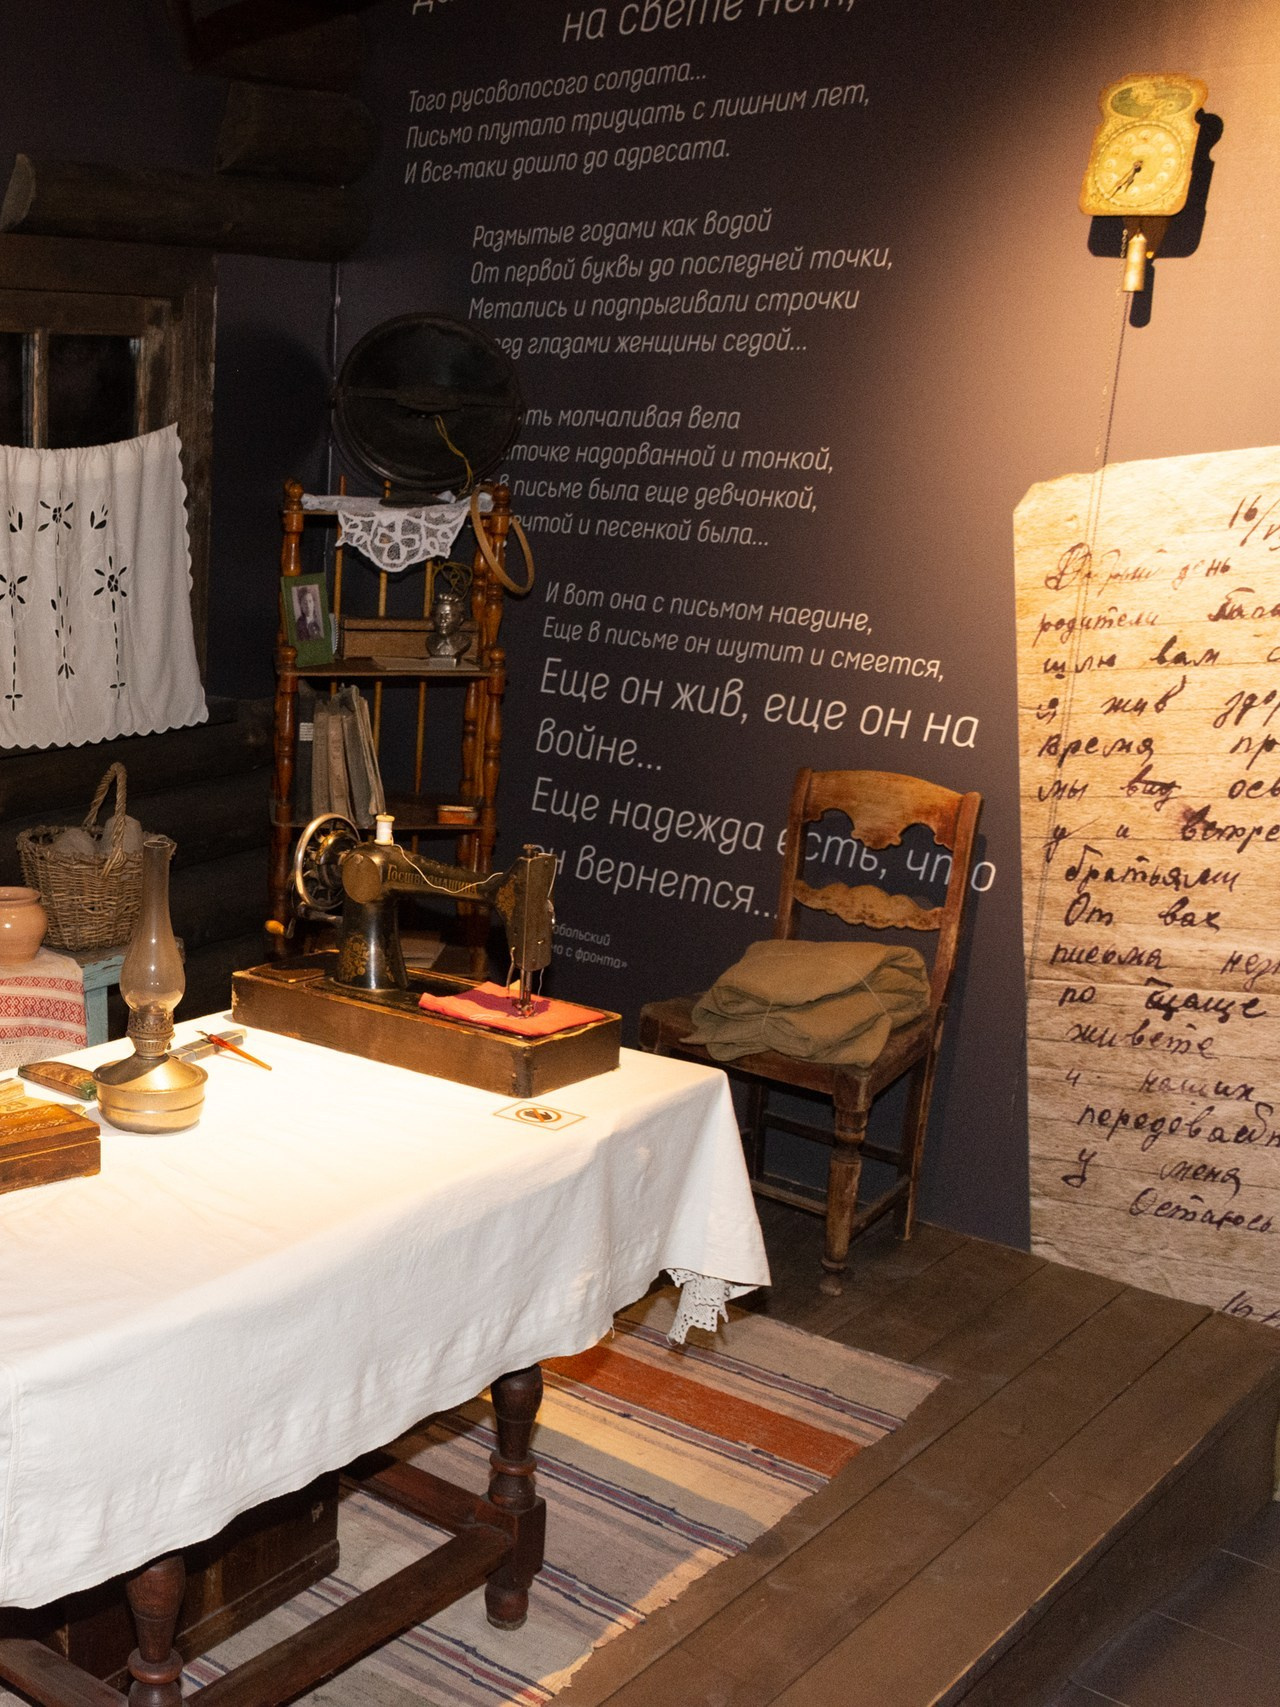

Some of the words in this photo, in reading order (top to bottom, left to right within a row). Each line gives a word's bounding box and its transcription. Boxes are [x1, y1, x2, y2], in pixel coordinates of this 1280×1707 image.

[562, 8, 607, 43] на
[409, 90, 446, 112] Того
[450, 75, 588, 113] русоволосого
[594, 62, 706, 93] солдата...
[406, 126, 473, 149] Письмо
[477, 116, 566, 145] плутало
[571, 104, 685, 136] тридцать
[692, 101, 706, 120] с
[710, 90, 807, 118] лишним
[811, 83, 869, 108] лет,
[404, 162, 417, 184] И
[421, 159, 508, 183] все-таки
[512, 152, 578, 181] дошло
[583, 149, 608, 175] до
[614, 139, 730, 171] адресата.
[472, 225, 575, 252] Размытые
[580, 220, 656, 246] годами
[661, 218, 698, 237] как
[703, 207, 772, 240] водой
[471, 261, 499, 284] От
[504, 258, 575, 286] первой
[581, 253, 644, 284] буквы
[648, 257, 675, 282] до
[680, 246, 804, 278] последней
[809, 247, 892, 270] точки,
[468, 297, 567, 319] Метались
[574, 300, 586, 317] и
[591, 289, 749, 321] подпрыгивали
[755, 290, 860, 316] строчки
[527, 336, 611, 359] глазами
[614, 334, 717, 355] женщины
[722, 327, 807, 358] седой...
[558, 404, 683, 428] молчаливая
[688, 404, 741, 429] вела
[575, 441, 716, 469] надорванной
[721, 450, 736, 468] и
[741, 447, 833, 474] тонкой,
[513, 480, 583, 499] письме
[588, 477, 639, 501] была
[645, 485, 689, 506] еще
[694, 482, 817, 513] девчонкой,
[578, 519, 591, 535] и
[595, 519, 692, 541] песенкой
[697, 519, 768, 546] была...
[545, 581, 560, 603] И
[563, 582, 604, 607] вот
[609, 592, 647, 611] она
[652, 596, 665, 613] с
[670, 597, 764, 621] письмом
[768, 606, 872, 635] наедине,
[543, 616, 583, 642] Еще
[587, 620, 601, 643] в
[605, 628, 679, 651] письме
[684, 635, 711, 654] он
[716, 639, 804, 664] шутит
[810, 648, 825, 666] и
[830, 650, 944, 682] смеется,
[540, 657, 610, 703] Еще
[620, 676, 664, 707] он
[670, 678, 748, 725] жив,
[764, 693, 847, 734] еще
[859, 704, 912, 739] он
[922, 712, 979, 748] на
[535, 717, 662, 771] войне...
[531, 776, 600, 823] Еще
[609, 799, 765, 855] надежда
